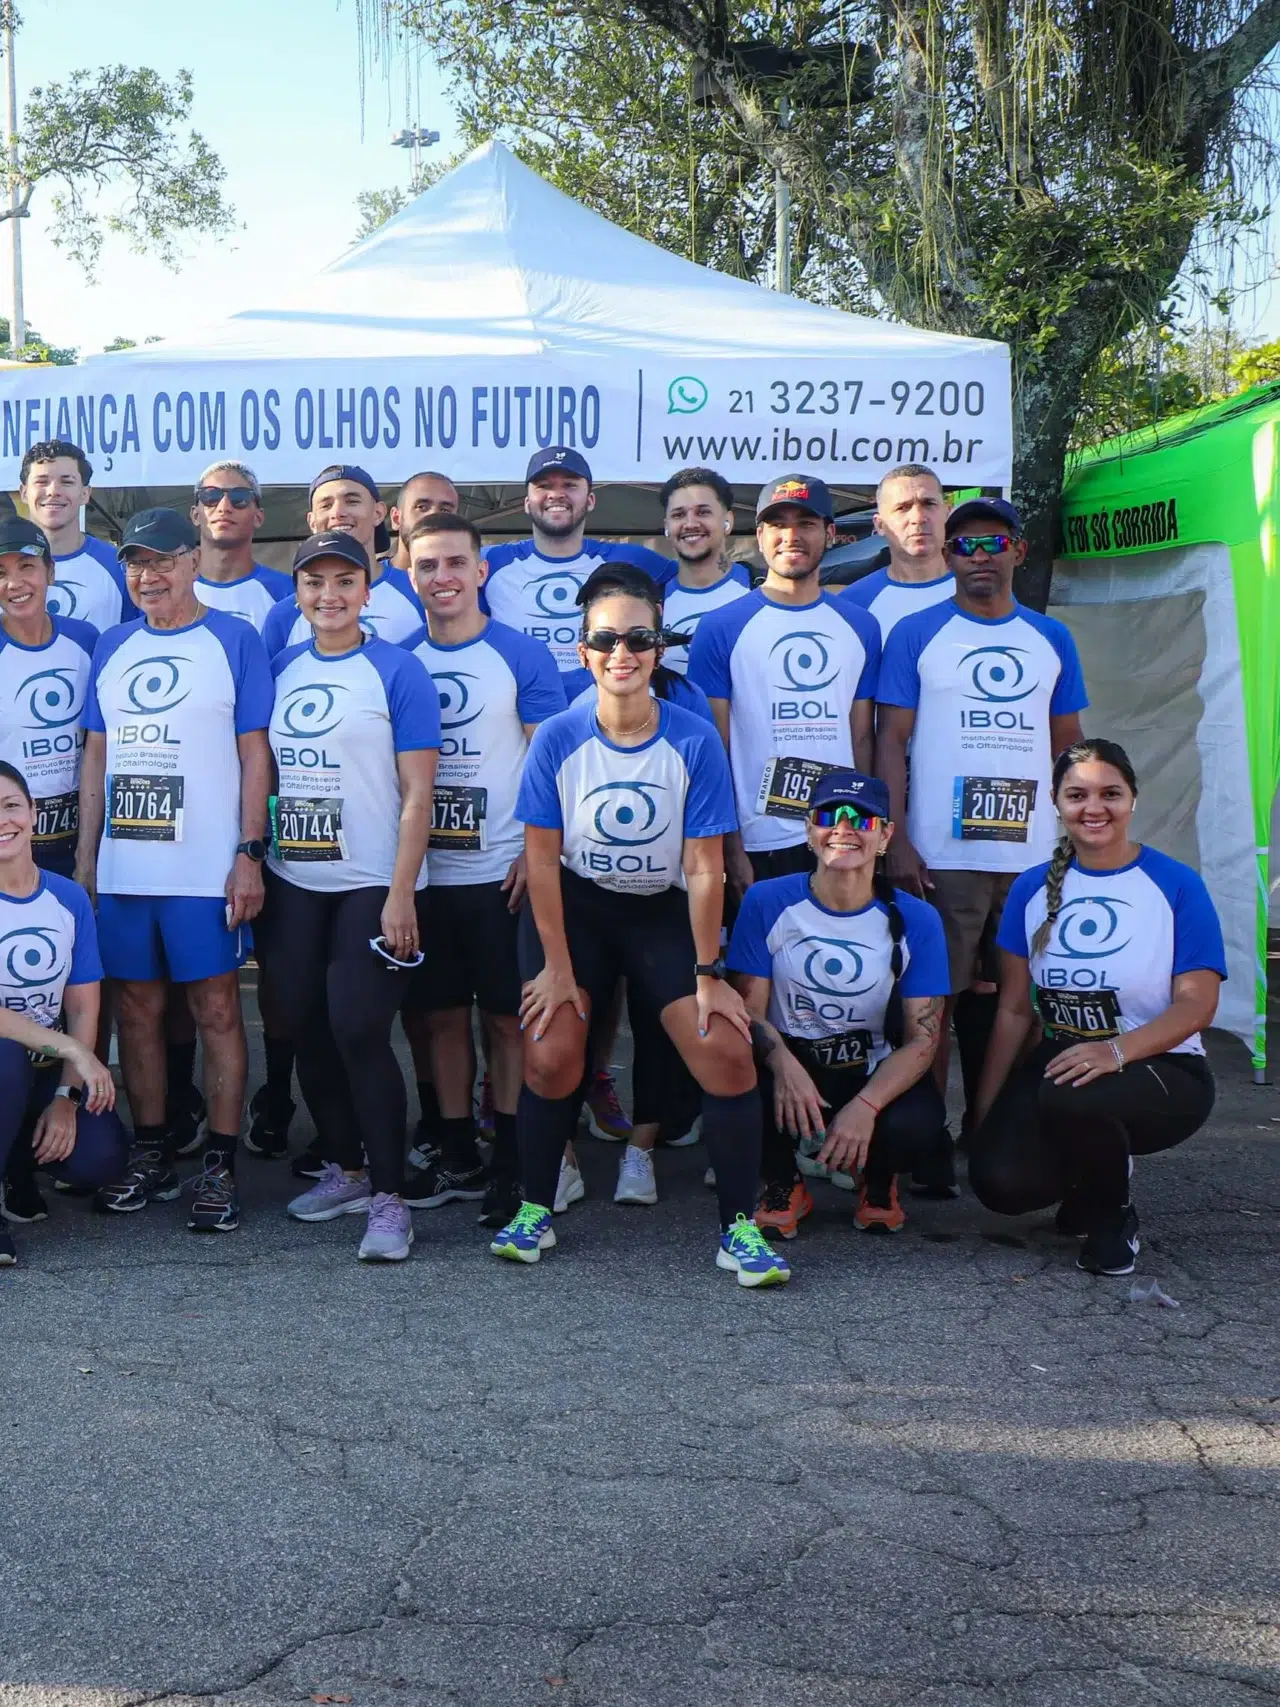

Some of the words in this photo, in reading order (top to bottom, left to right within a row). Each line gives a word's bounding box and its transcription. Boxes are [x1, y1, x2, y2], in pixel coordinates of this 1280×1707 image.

[729, 389, 754, 413] 21
[770, 380, 985, 416] 3237-9200
[152, 391, 226, 452] COM
[240, 388, 281, 450] OS
[294, 386, 401, 449] OLHOS
[415, 385, 457, 448] NO
[472, 385, 600, 449] FUTURO
[663, 427, 983, 463] www.ibol.com.br
[1067, 515, 1090, 553] FOI
[1091, 506, 1111, 552] SÓ
[1112, 498, 1179, 549] CORRIDA
[772, 701, 838, 720] IBOL
[960, 710, 1034, 730] IBOL
[117, 724, 181, 744] IBOL
[439, 738, 481, 756] OL
[139, 751, 179, 759] Brasileiro
[759, 766, 772, 800] BRANCO
[782, 772, 820, 802] 195
[32, 805, 79, 835] 0743
[116, 791, 172, 820] 20764
[972, 792, 1028, 822] 20759
[281, 813, 334, 841] 20744
[582, 851, 667, 873] IBOL
[1041, 968, 1120, 991] IBOL
[787, 993, 866, 1022] IBOL
[1050, 1001, 1108, 1031] 20761
[811, 1041, 863, 1065] 742
